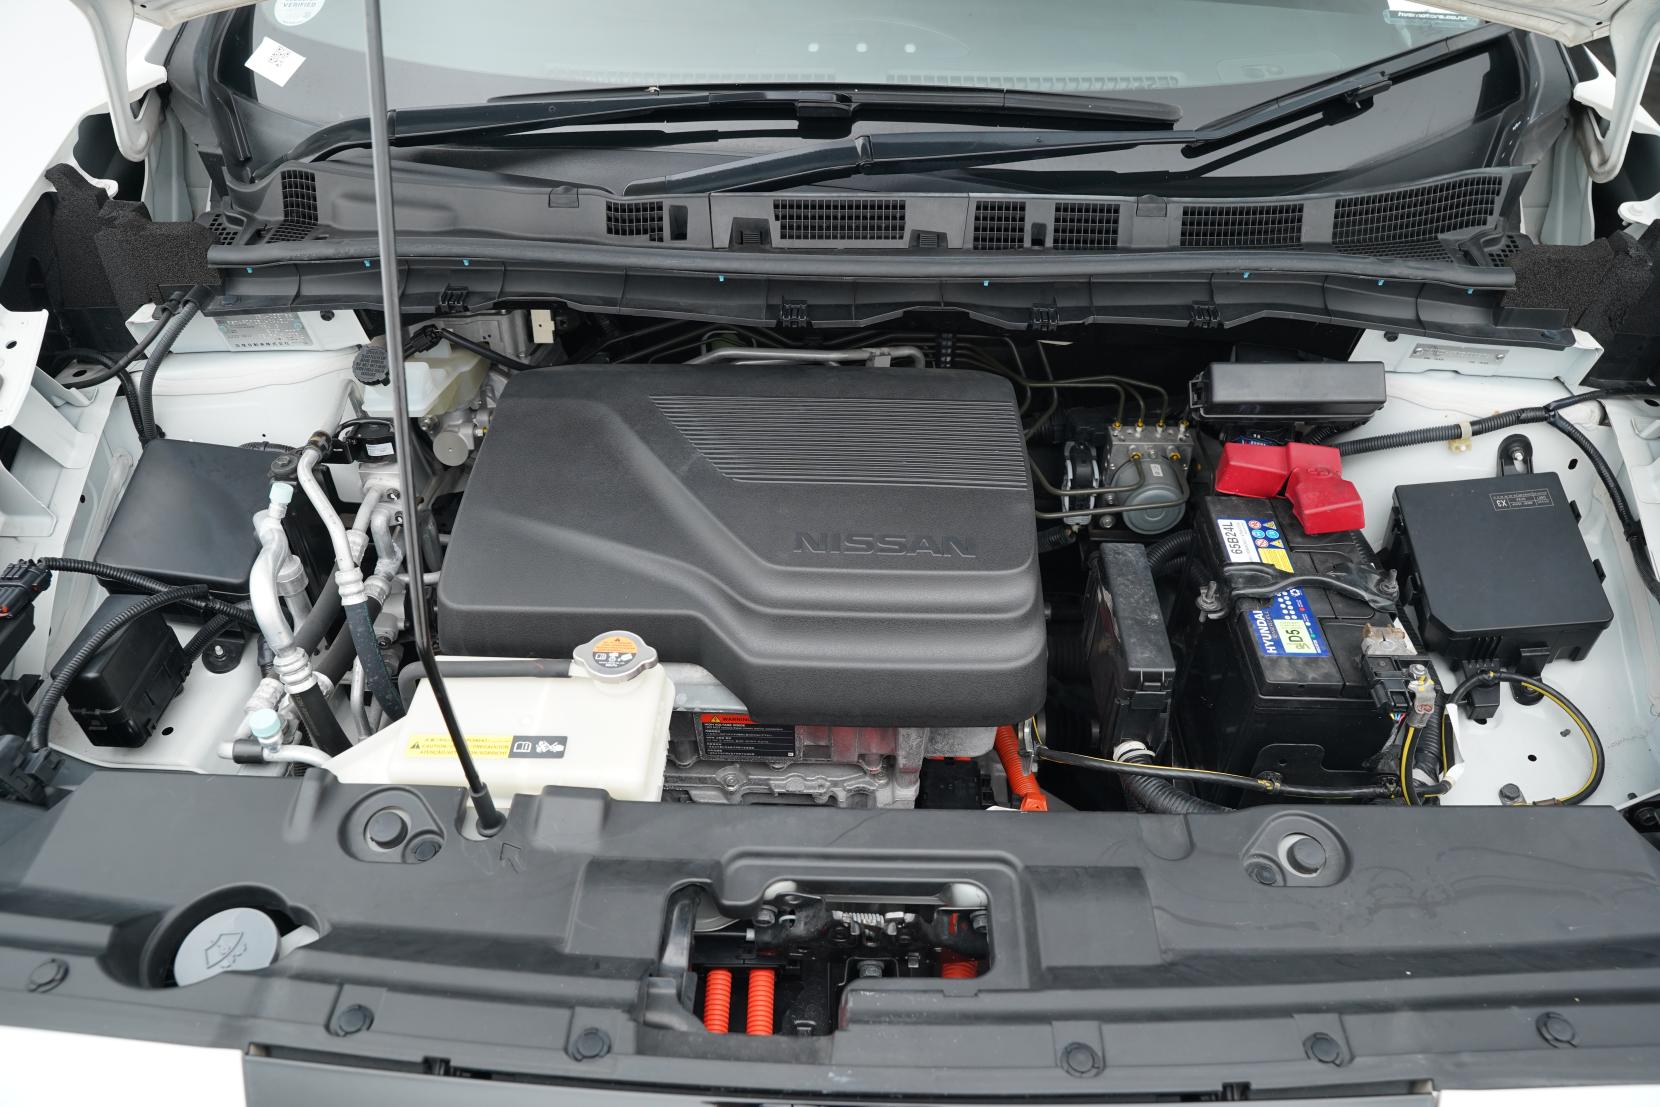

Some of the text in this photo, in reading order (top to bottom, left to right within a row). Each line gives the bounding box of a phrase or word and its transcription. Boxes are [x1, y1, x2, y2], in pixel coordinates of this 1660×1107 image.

[793, 532, 977, 558] NISSAN
[1222, 521, 1243, 555] 65B24L
[1252, 610, 1277, 654] HYUNDAI
[1285, 629, 1304, 643] D5
